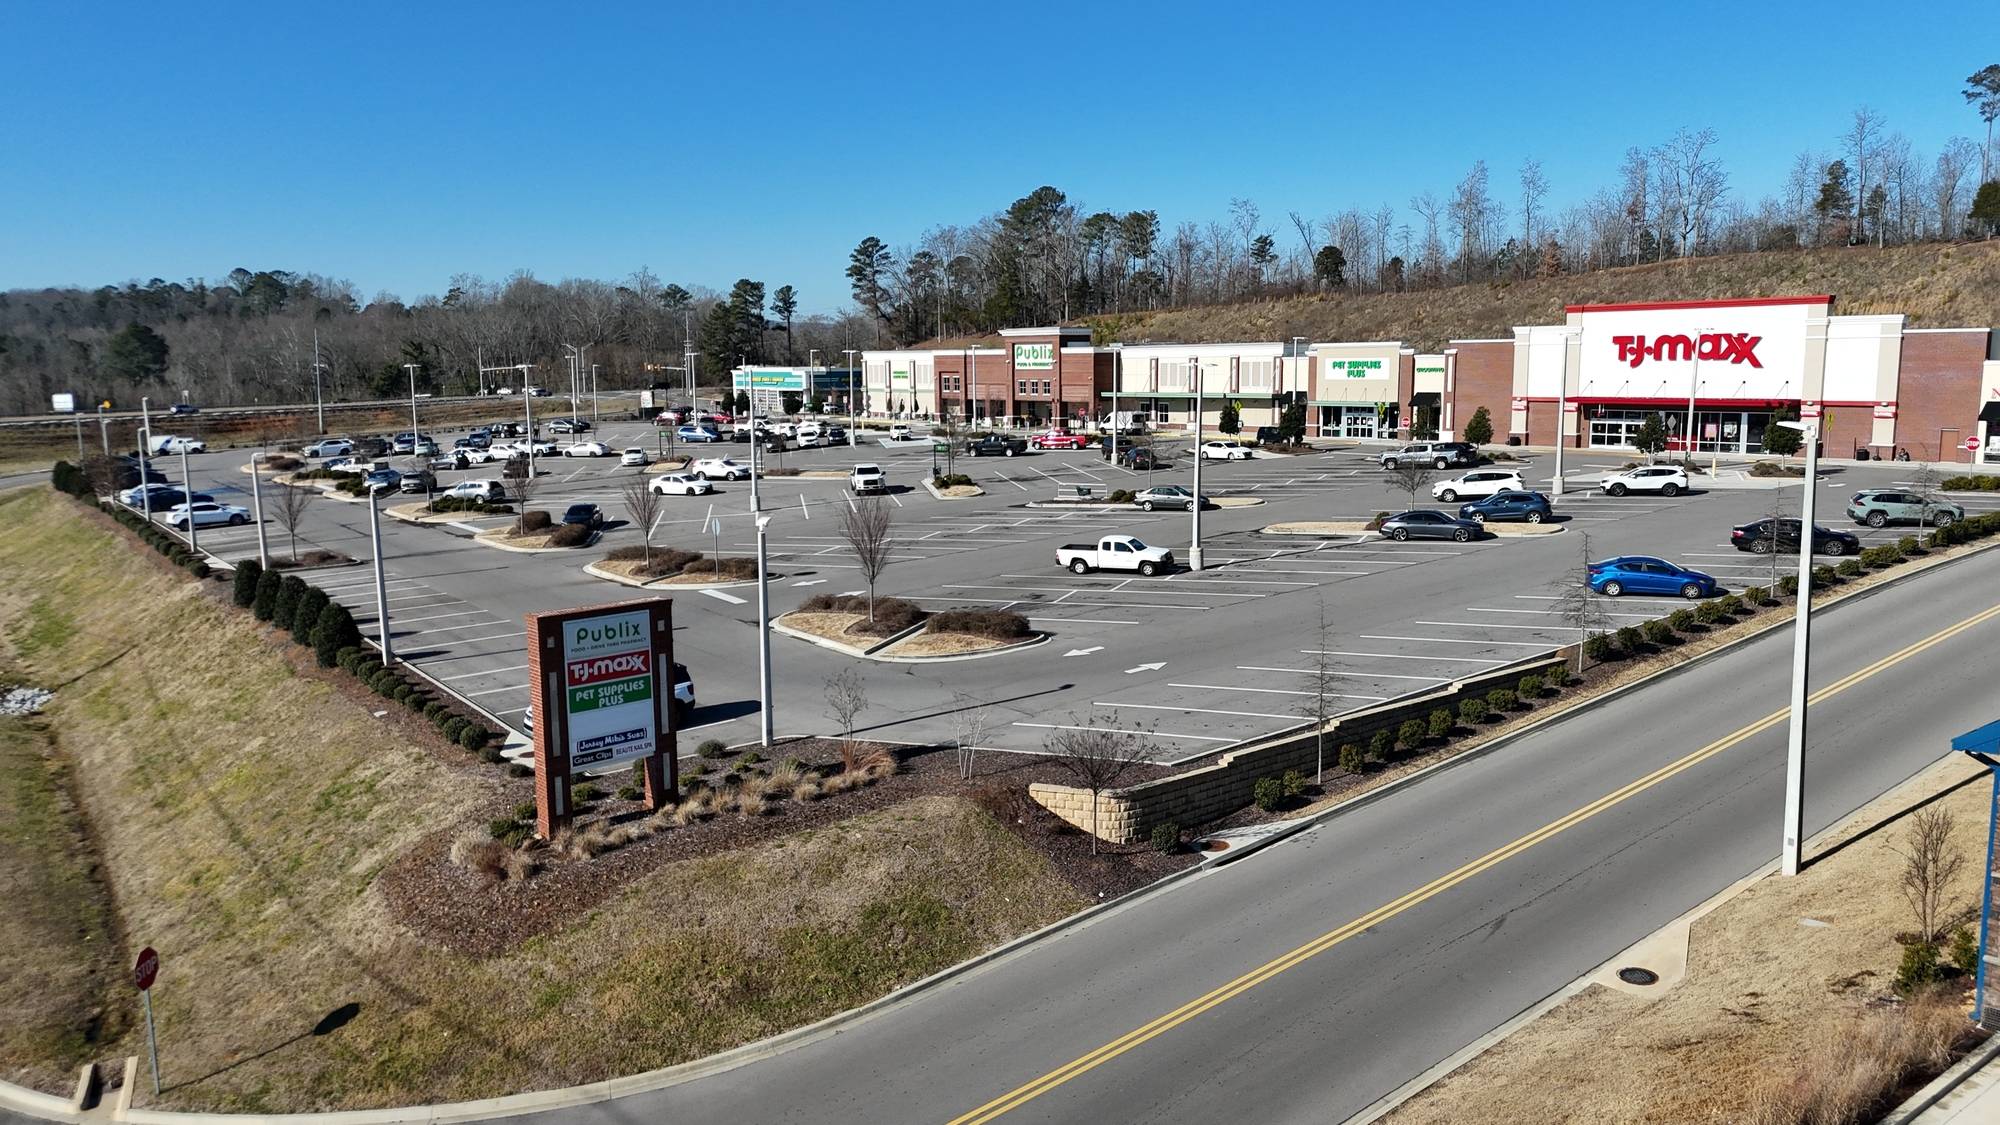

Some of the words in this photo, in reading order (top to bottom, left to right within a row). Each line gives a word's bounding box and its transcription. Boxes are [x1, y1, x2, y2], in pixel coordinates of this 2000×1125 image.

[1016, 346, 1054, 359] Publix
[1332, 360, 1346, 369] PET
[1347, 360, 1381, 369] SUPPLIES
[1347, 369, 1365, 378] PLUS
[576, 621, 640, 645] Publix
[576, 689, 595, 702] PET
[598, 680, 645, 698] SUPPLIES
[599, 695, 624, 707] PLUS
[580, 740, 604, 750] Jersey
[626, 730, 644, 740] Subs
[643, 741, 652, 749] SPA
[573, 755, 594, 764] Great
[595, 751, 612, 761] Clips
[136, 955, 156, 983] STOP
